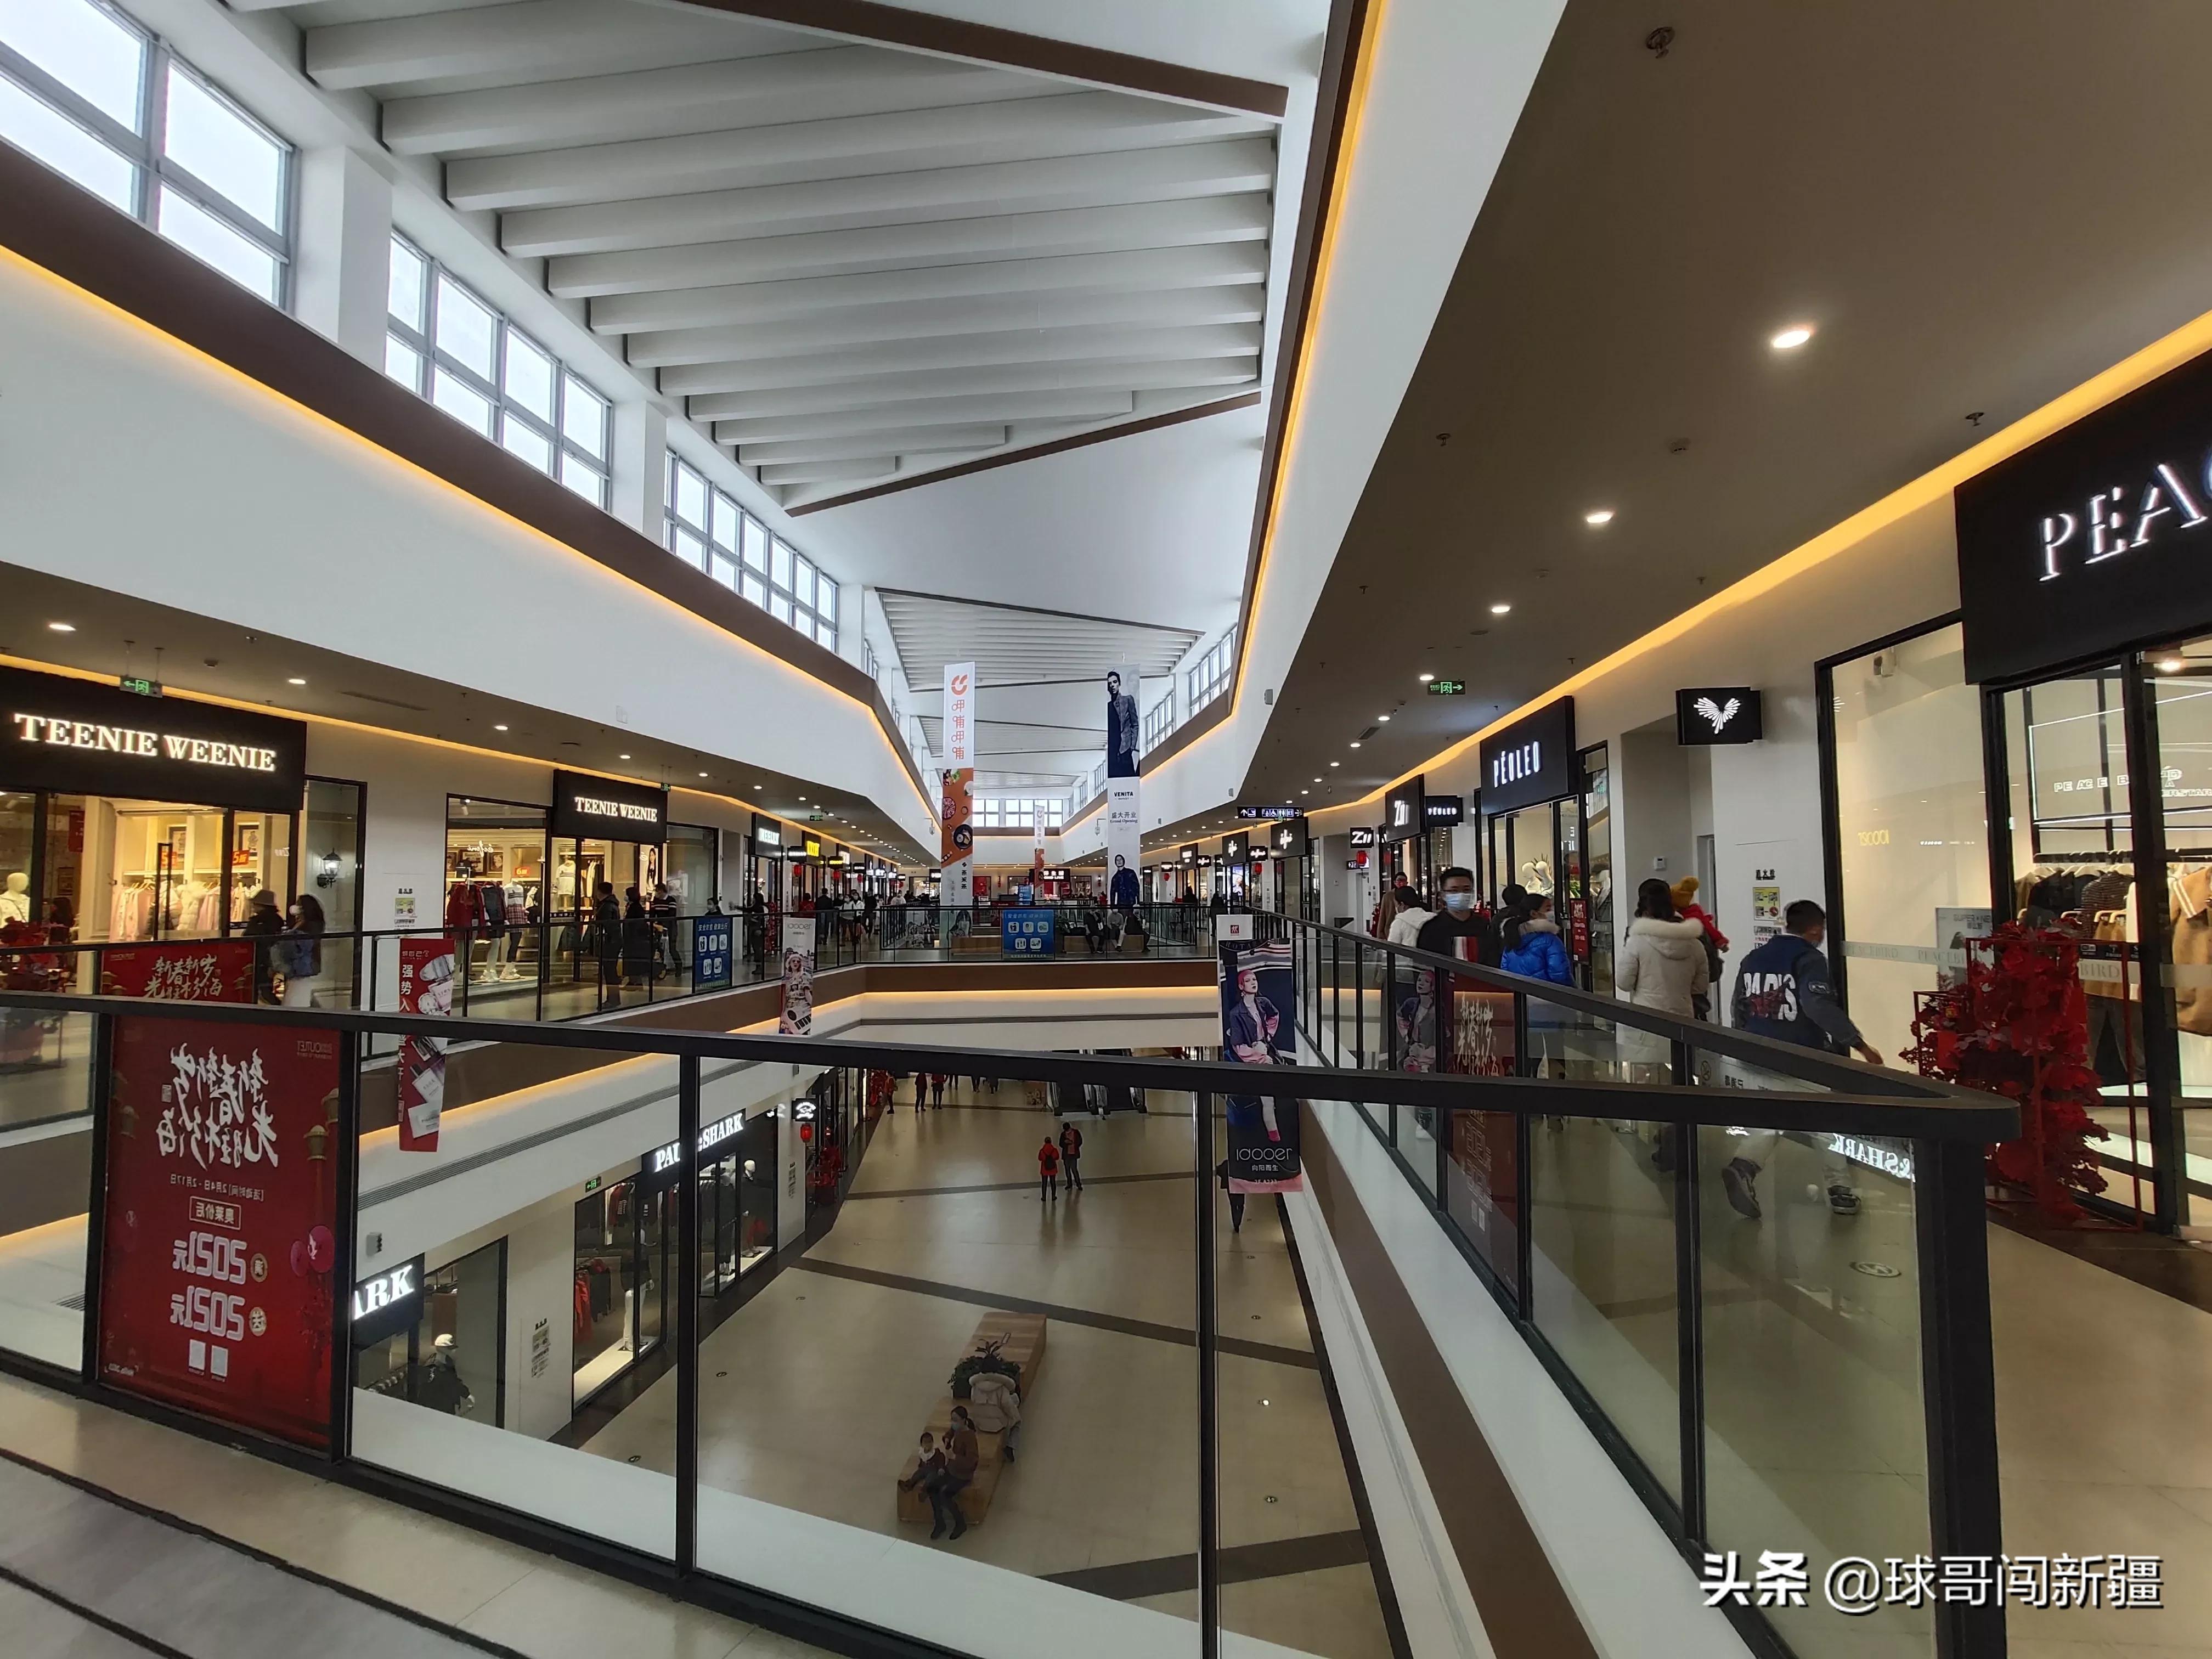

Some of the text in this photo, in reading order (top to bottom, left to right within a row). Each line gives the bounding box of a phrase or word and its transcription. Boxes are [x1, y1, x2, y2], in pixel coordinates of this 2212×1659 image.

[14, 713, 276, 771] TEENIE WEENIE
[951, 699, 966, 760] 呷哺呷哺
[574, 797, 658, 822] TEENIE WEENIE
[399, 964, 414, 1013] 强势入
